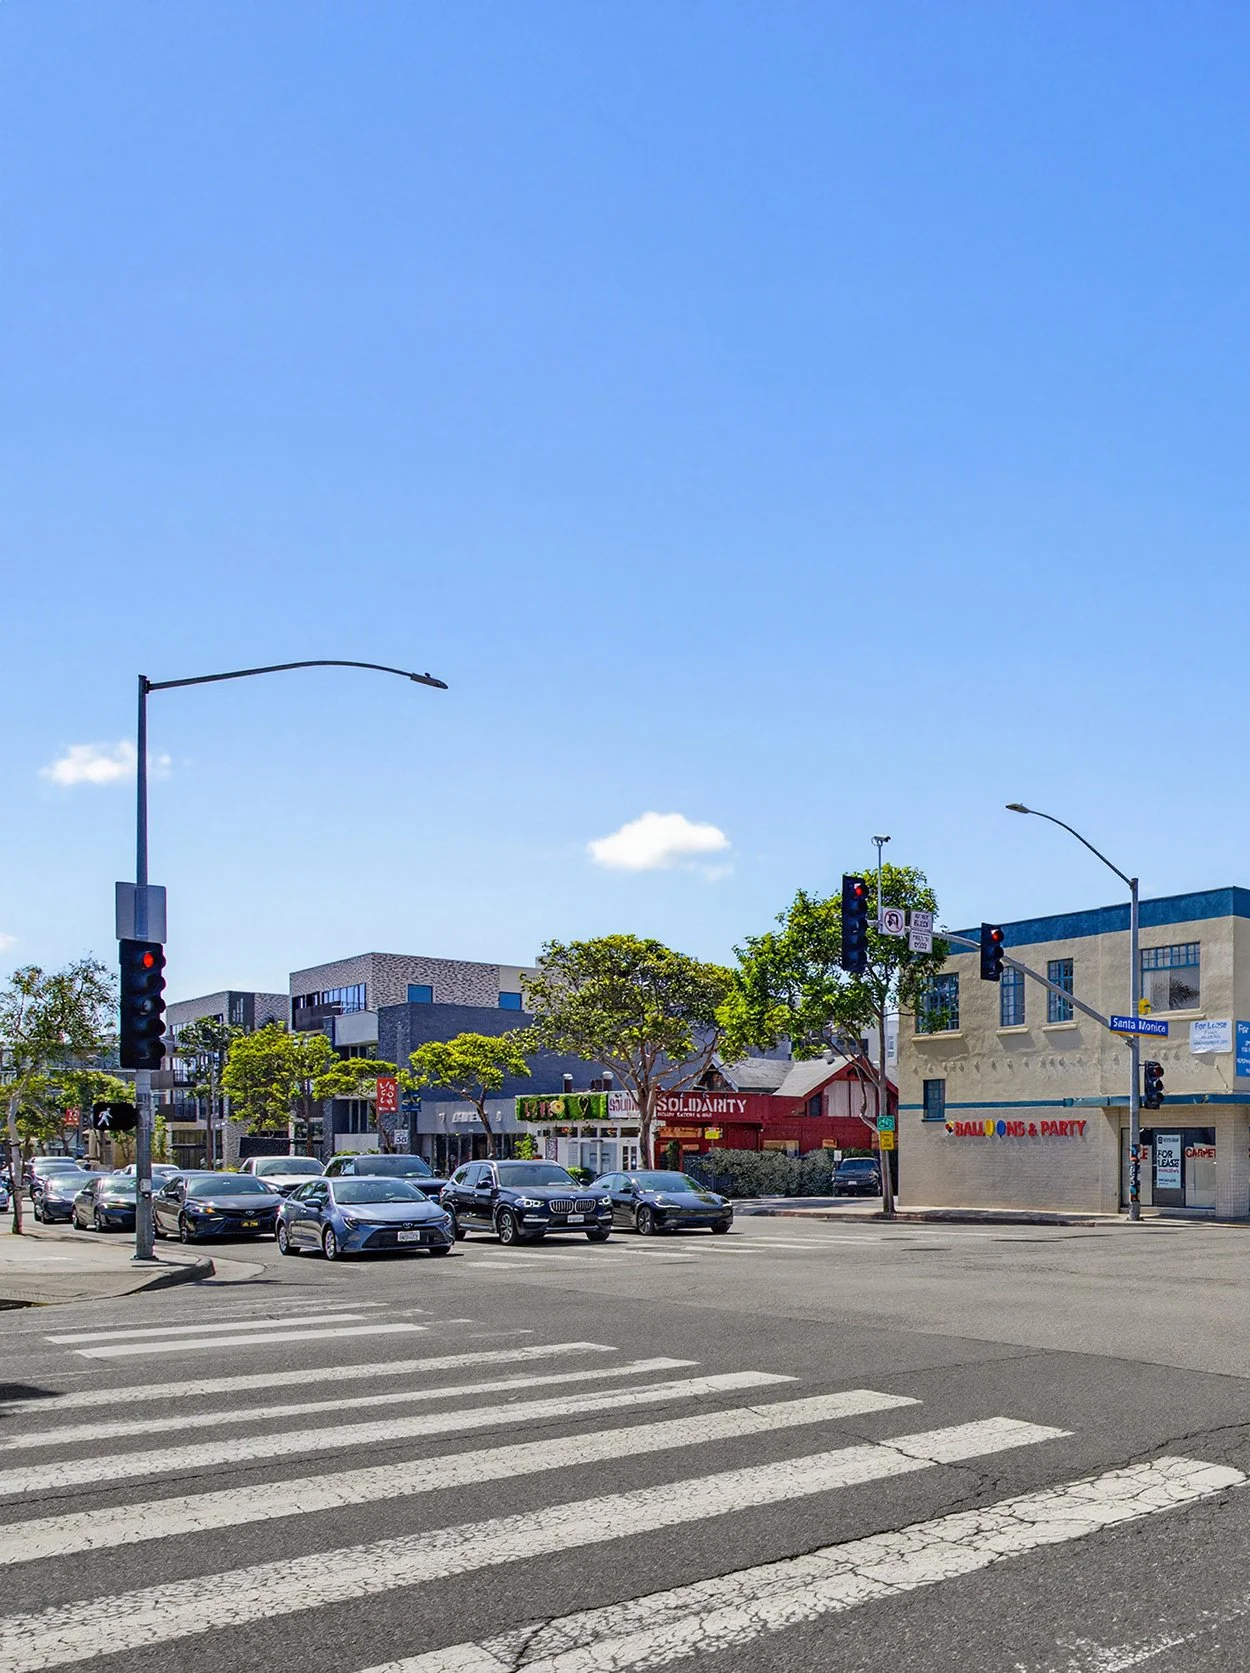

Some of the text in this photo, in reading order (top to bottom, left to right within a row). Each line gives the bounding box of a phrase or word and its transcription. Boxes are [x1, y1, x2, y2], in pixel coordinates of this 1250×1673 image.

[1113, 1017, 1166, 1033] Santa Monica
[656, 1097, 747, 1113] SOLIDARITY
[1028, 1122, 1038, 1137] &
[1040, 1120, 1087, 1137] PARTY
[1157, 1150, 1173, 1158] FOR
[1157, 1159, 1179, 1168] LEASE
